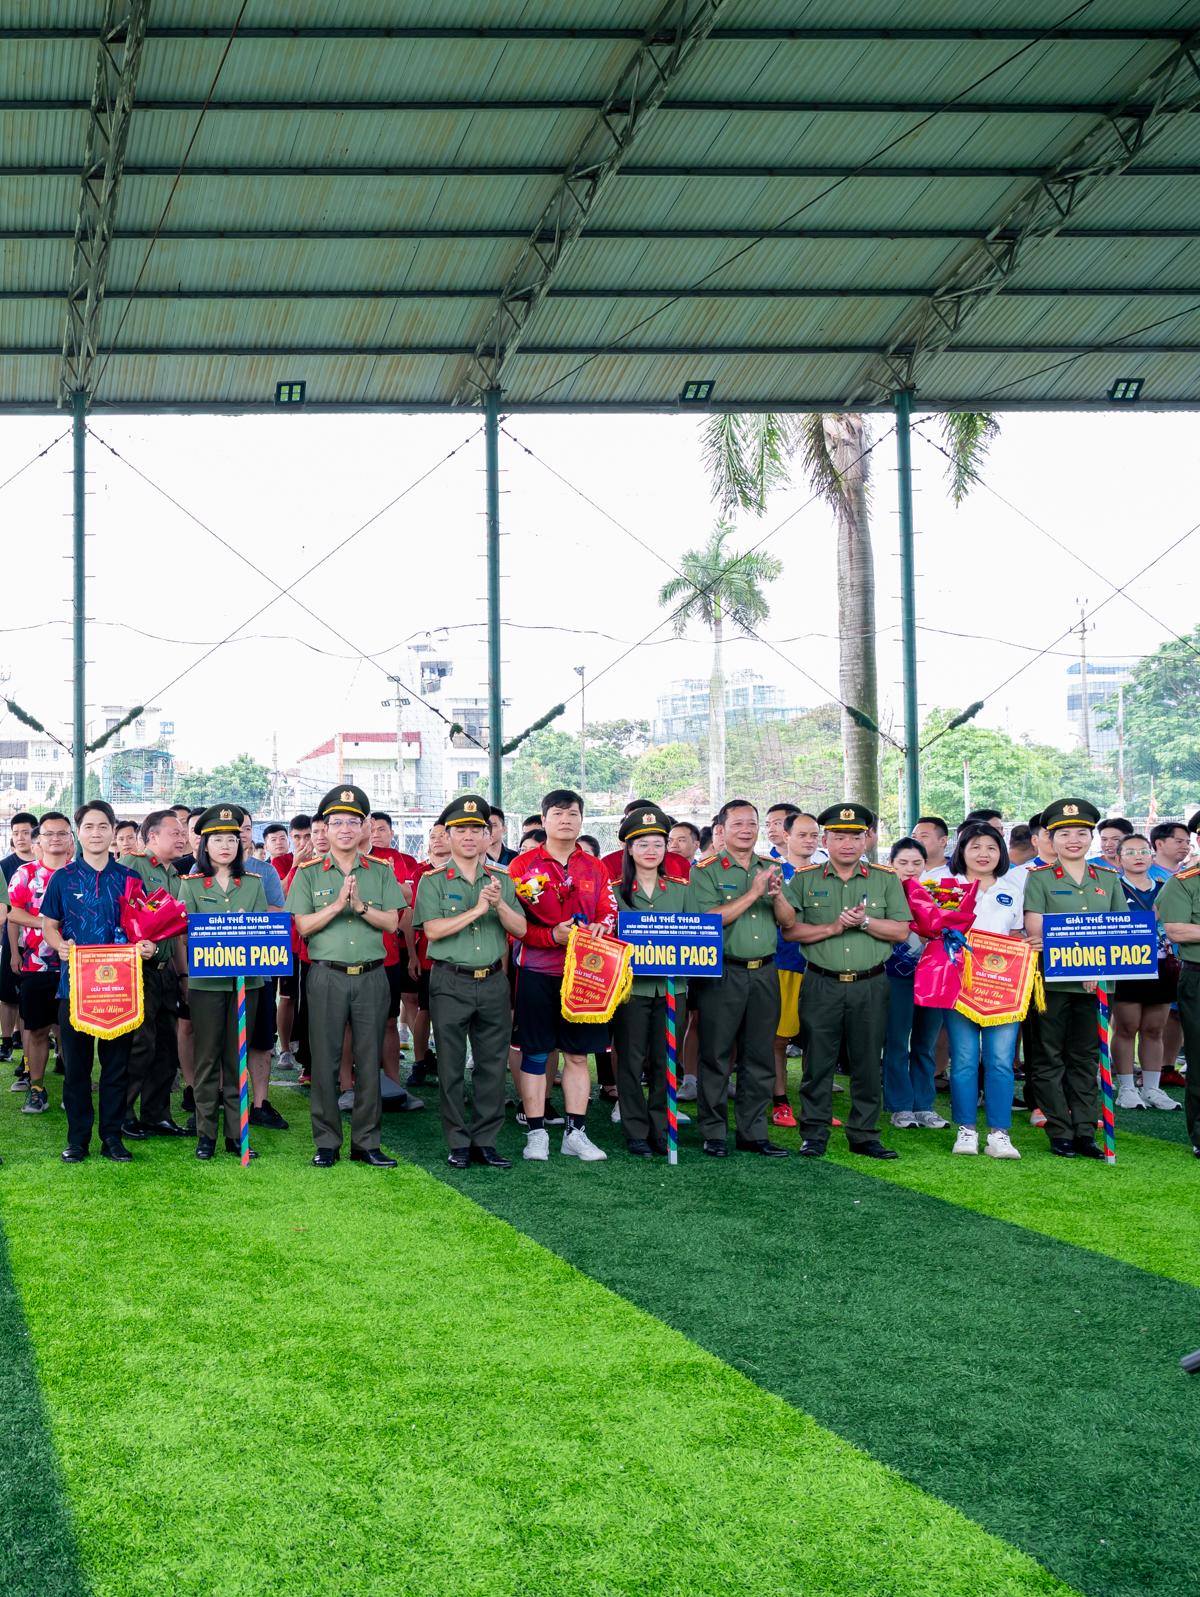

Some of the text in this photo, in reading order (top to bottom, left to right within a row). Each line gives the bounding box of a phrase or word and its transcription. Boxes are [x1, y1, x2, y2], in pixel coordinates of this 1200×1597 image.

[227, 915, 244, 923] THỂ
[659, 914, 675, 923] THỂ
[1086, 914, 1103, 923] THỂ
[194, 942, 288, 967] PHÒNG PA04
[681, 946, 717, 966] PA03
[1050, 942, 1106, 967] PHÒNG
[1110, 945, 1151, 965] PA02
